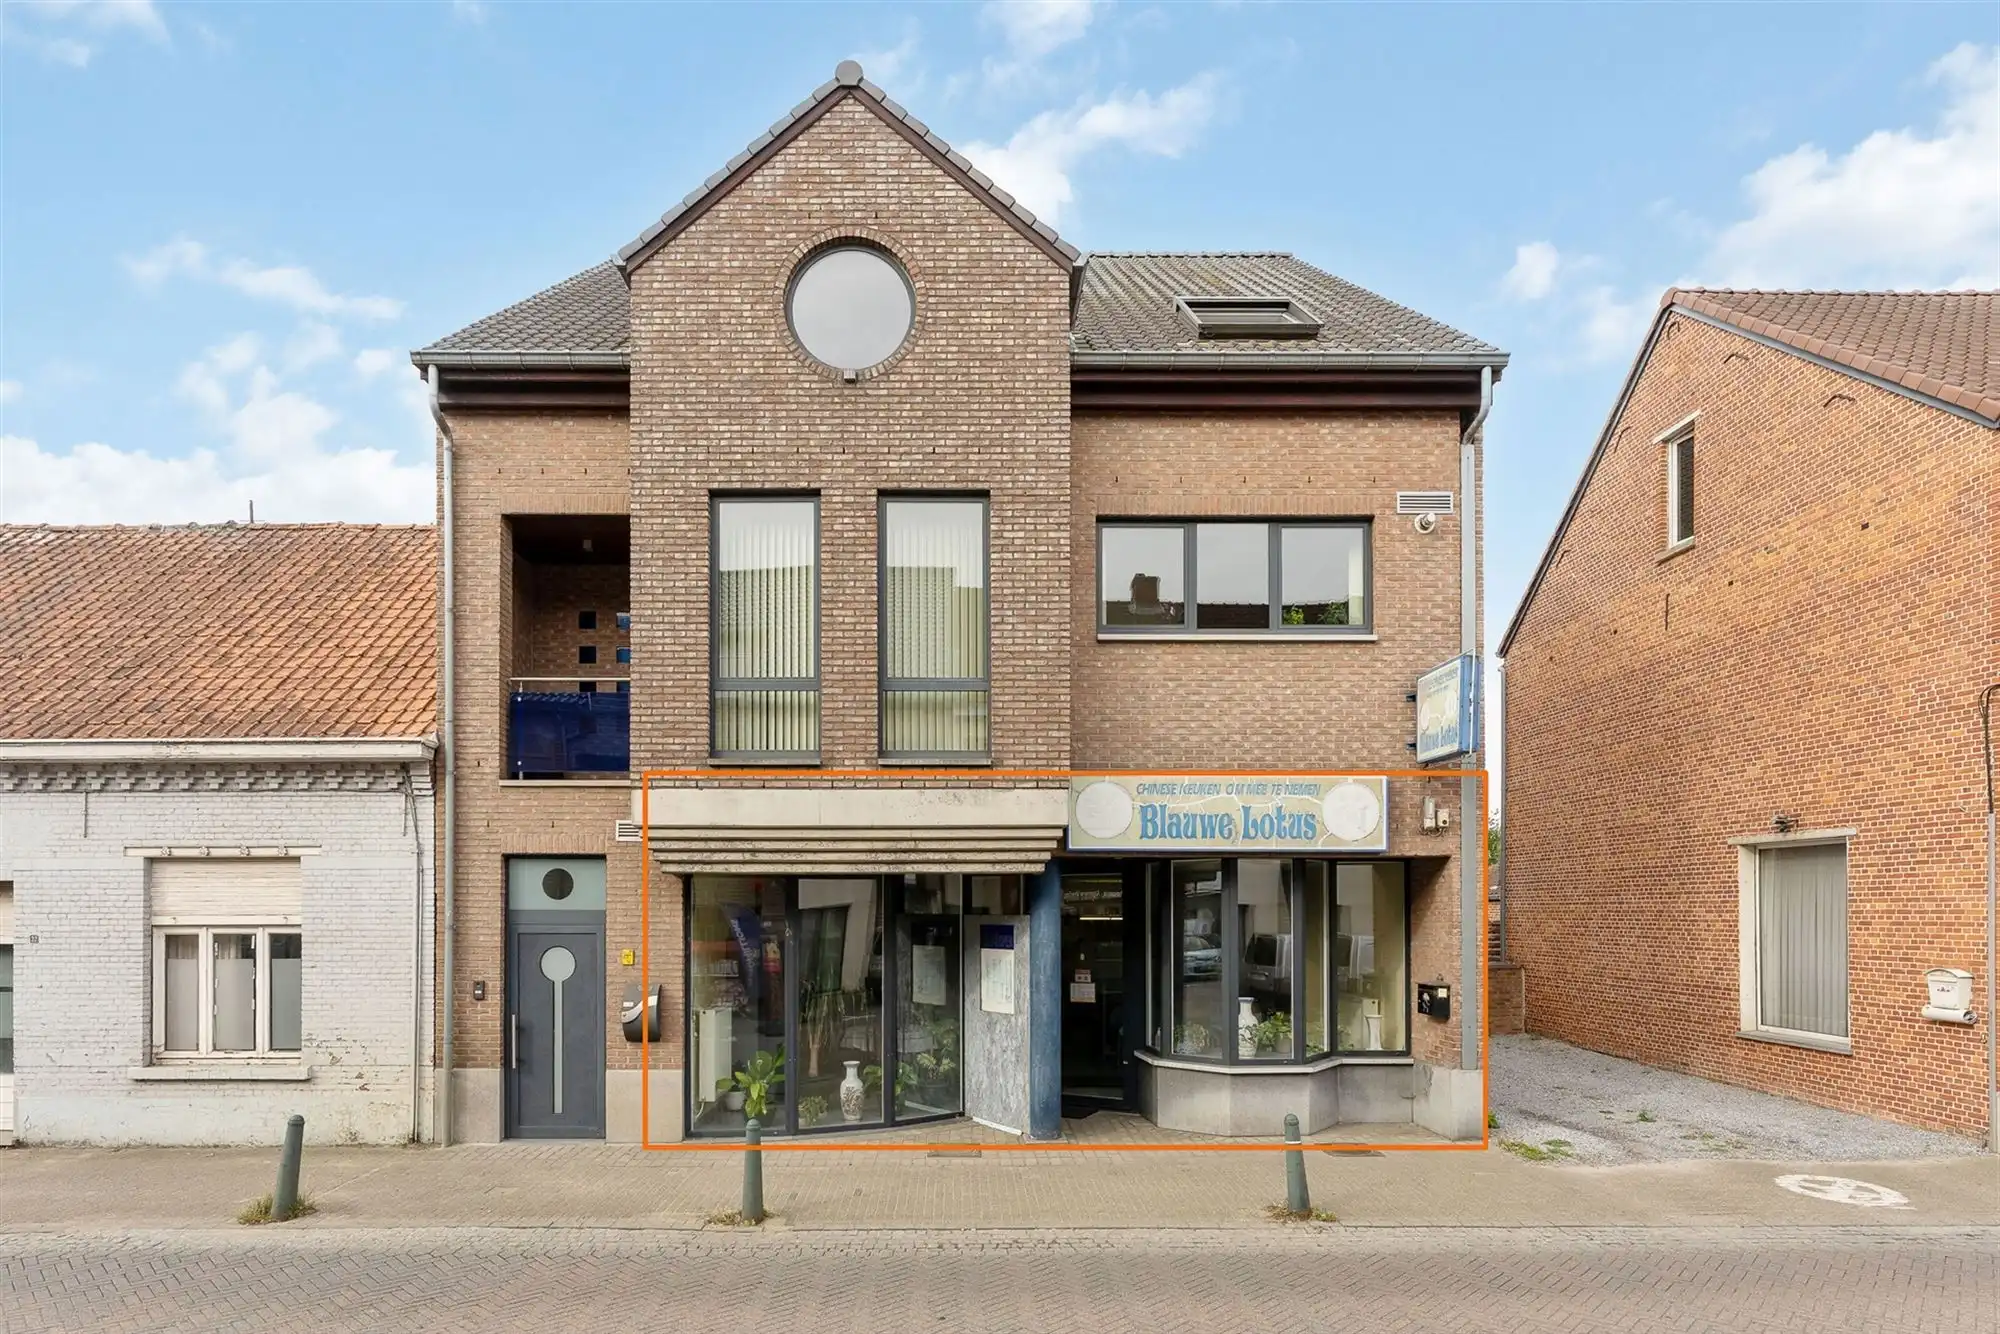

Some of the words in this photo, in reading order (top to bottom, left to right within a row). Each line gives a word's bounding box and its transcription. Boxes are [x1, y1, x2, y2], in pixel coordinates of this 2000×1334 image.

[1136, 783, 1178, 795] CHINESE
[1179, 783, 1221, 795] KEUKEN
[1226, 783, 1245, 796] OM
[1246, 783, 1268, 796] MEE
[1271, 783, 1284, 796] TE
[1284, 783, 1321, 796] NEMEN
[1139, 803, 1234, 841] Blauwe
[1240, 804, 1318, 841] Lotus
